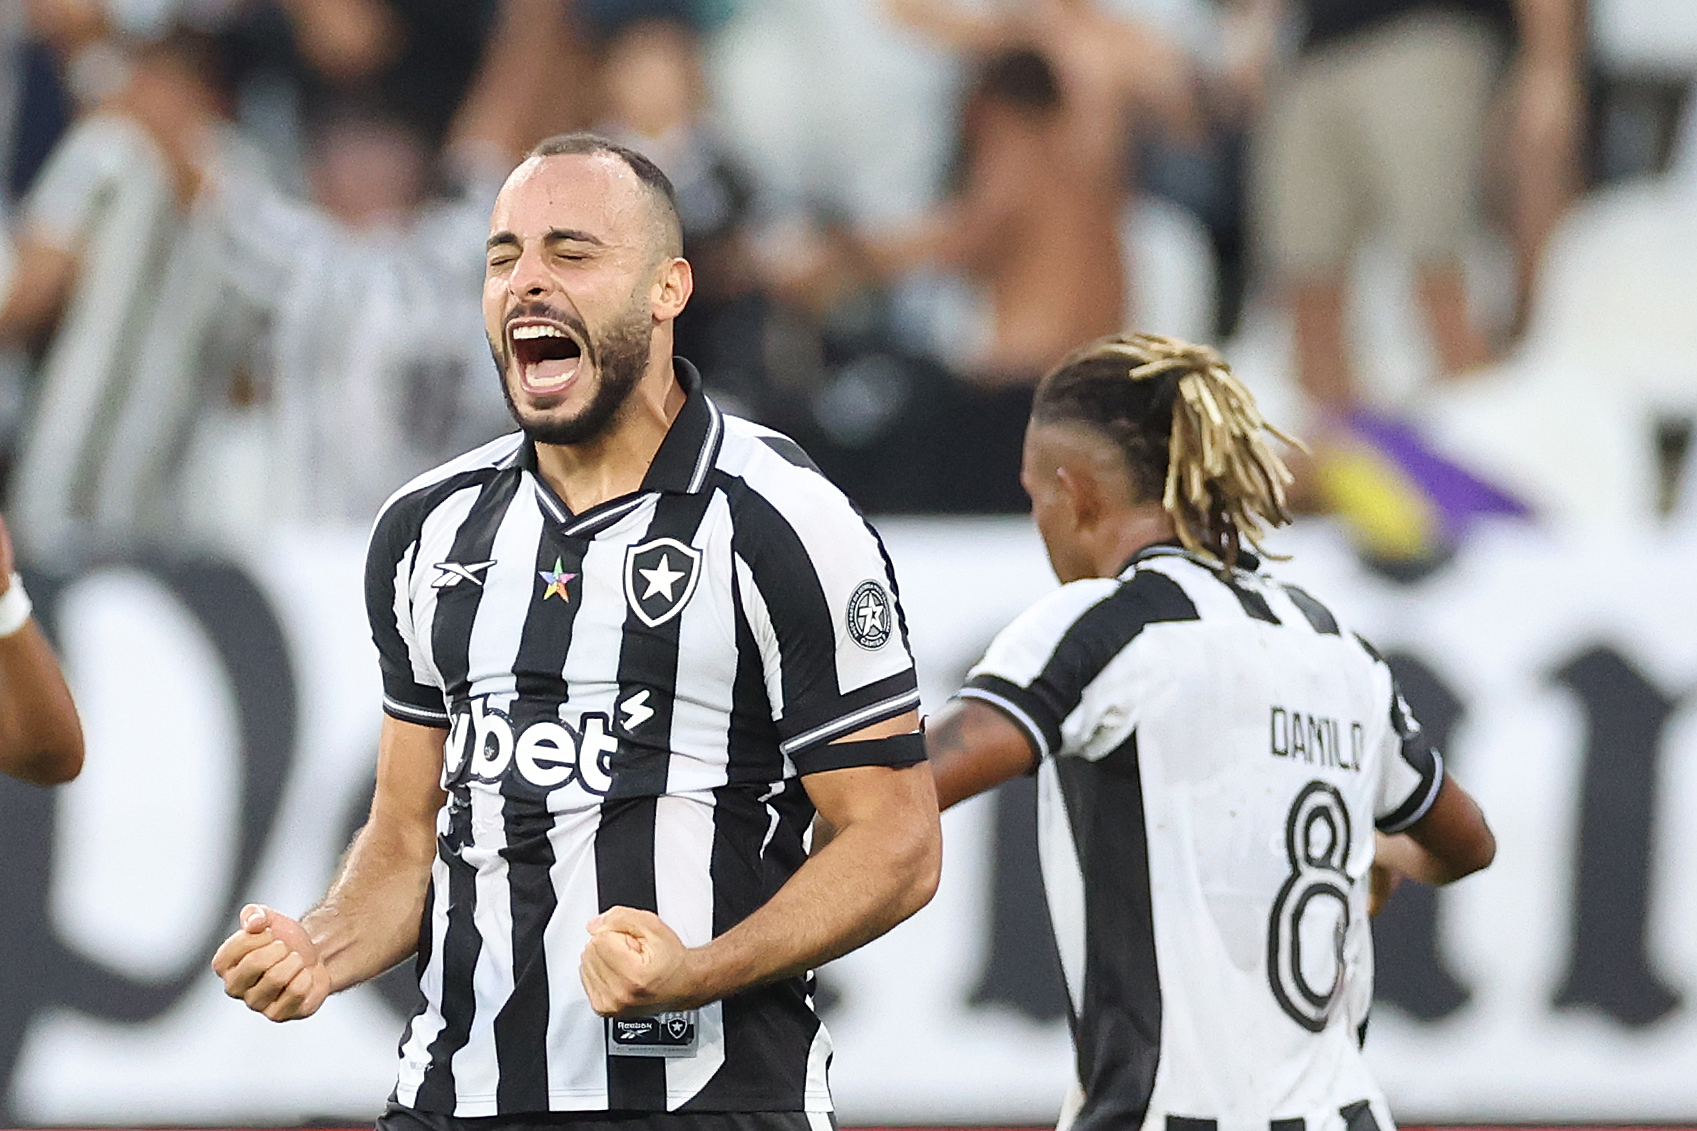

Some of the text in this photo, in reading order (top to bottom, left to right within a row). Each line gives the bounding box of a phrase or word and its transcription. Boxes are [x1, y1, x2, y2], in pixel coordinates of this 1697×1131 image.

[1270, 707, 1364, 772] DANILO
[1267, 780, 1354, 1032] 8
[617, 1021, 652, 1030] Reebok
